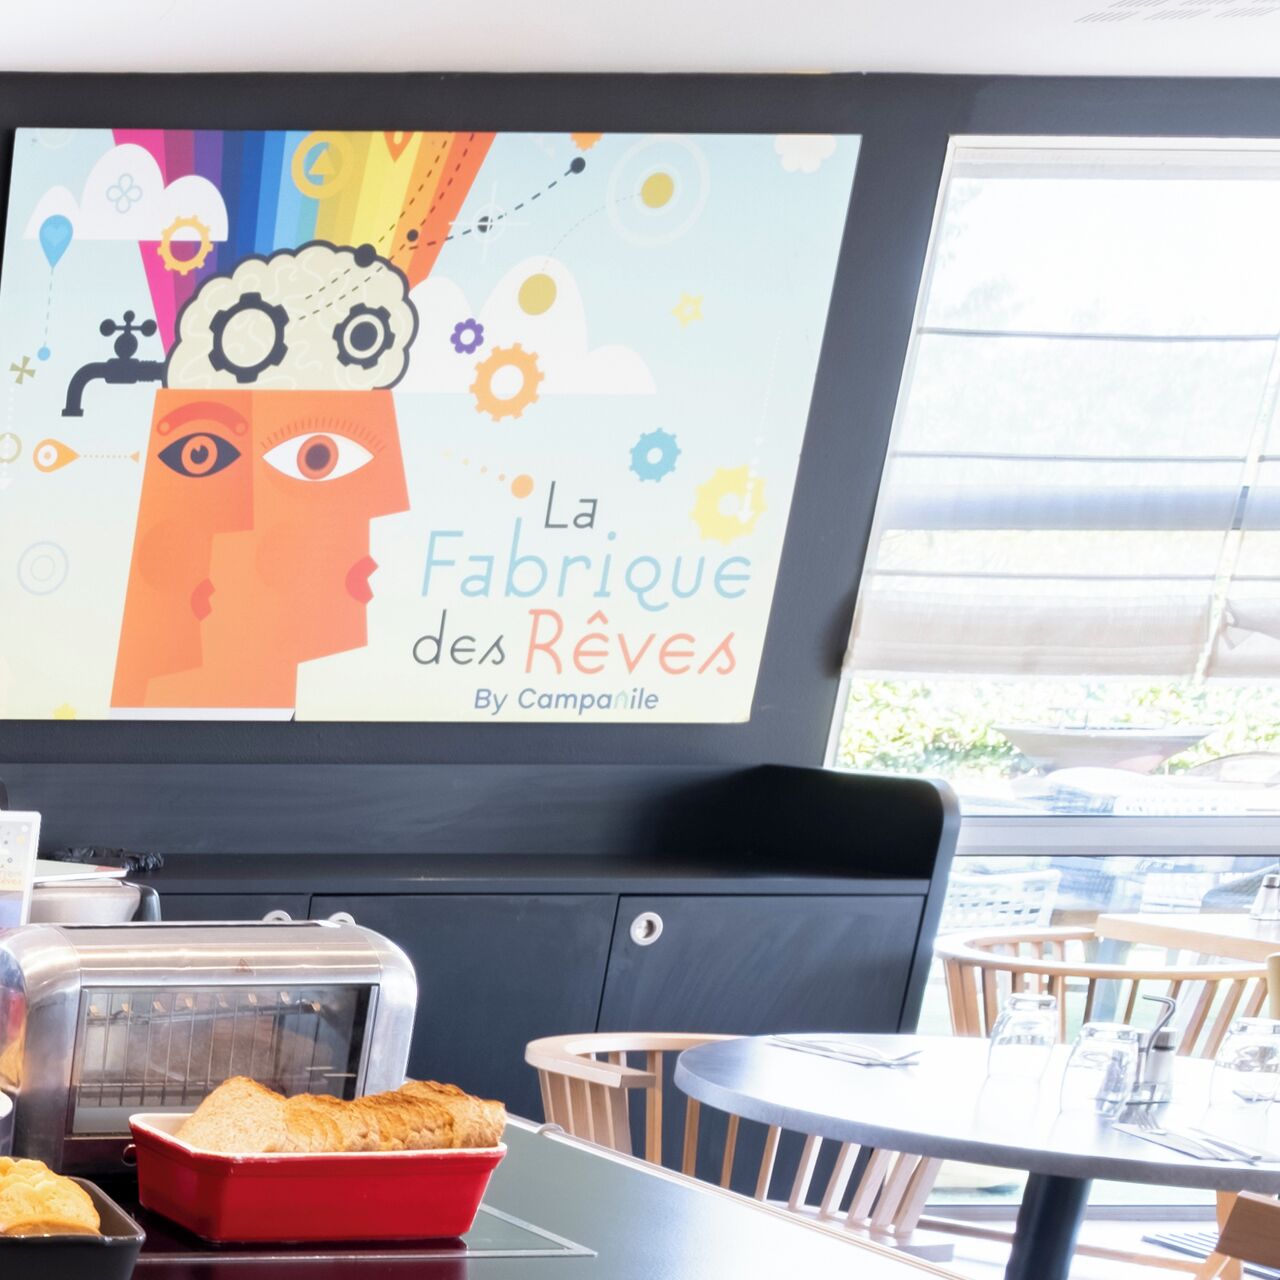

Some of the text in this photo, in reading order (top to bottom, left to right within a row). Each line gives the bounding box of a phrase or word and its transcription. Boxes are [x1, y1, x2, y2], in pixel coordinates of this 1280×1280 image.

[544, 480, 598, 529] La
[421, 517, 752, 612] Fabrique
[412, 607, 737, 676] des Rêves
[473, 686, 660, 717] By Campanile
